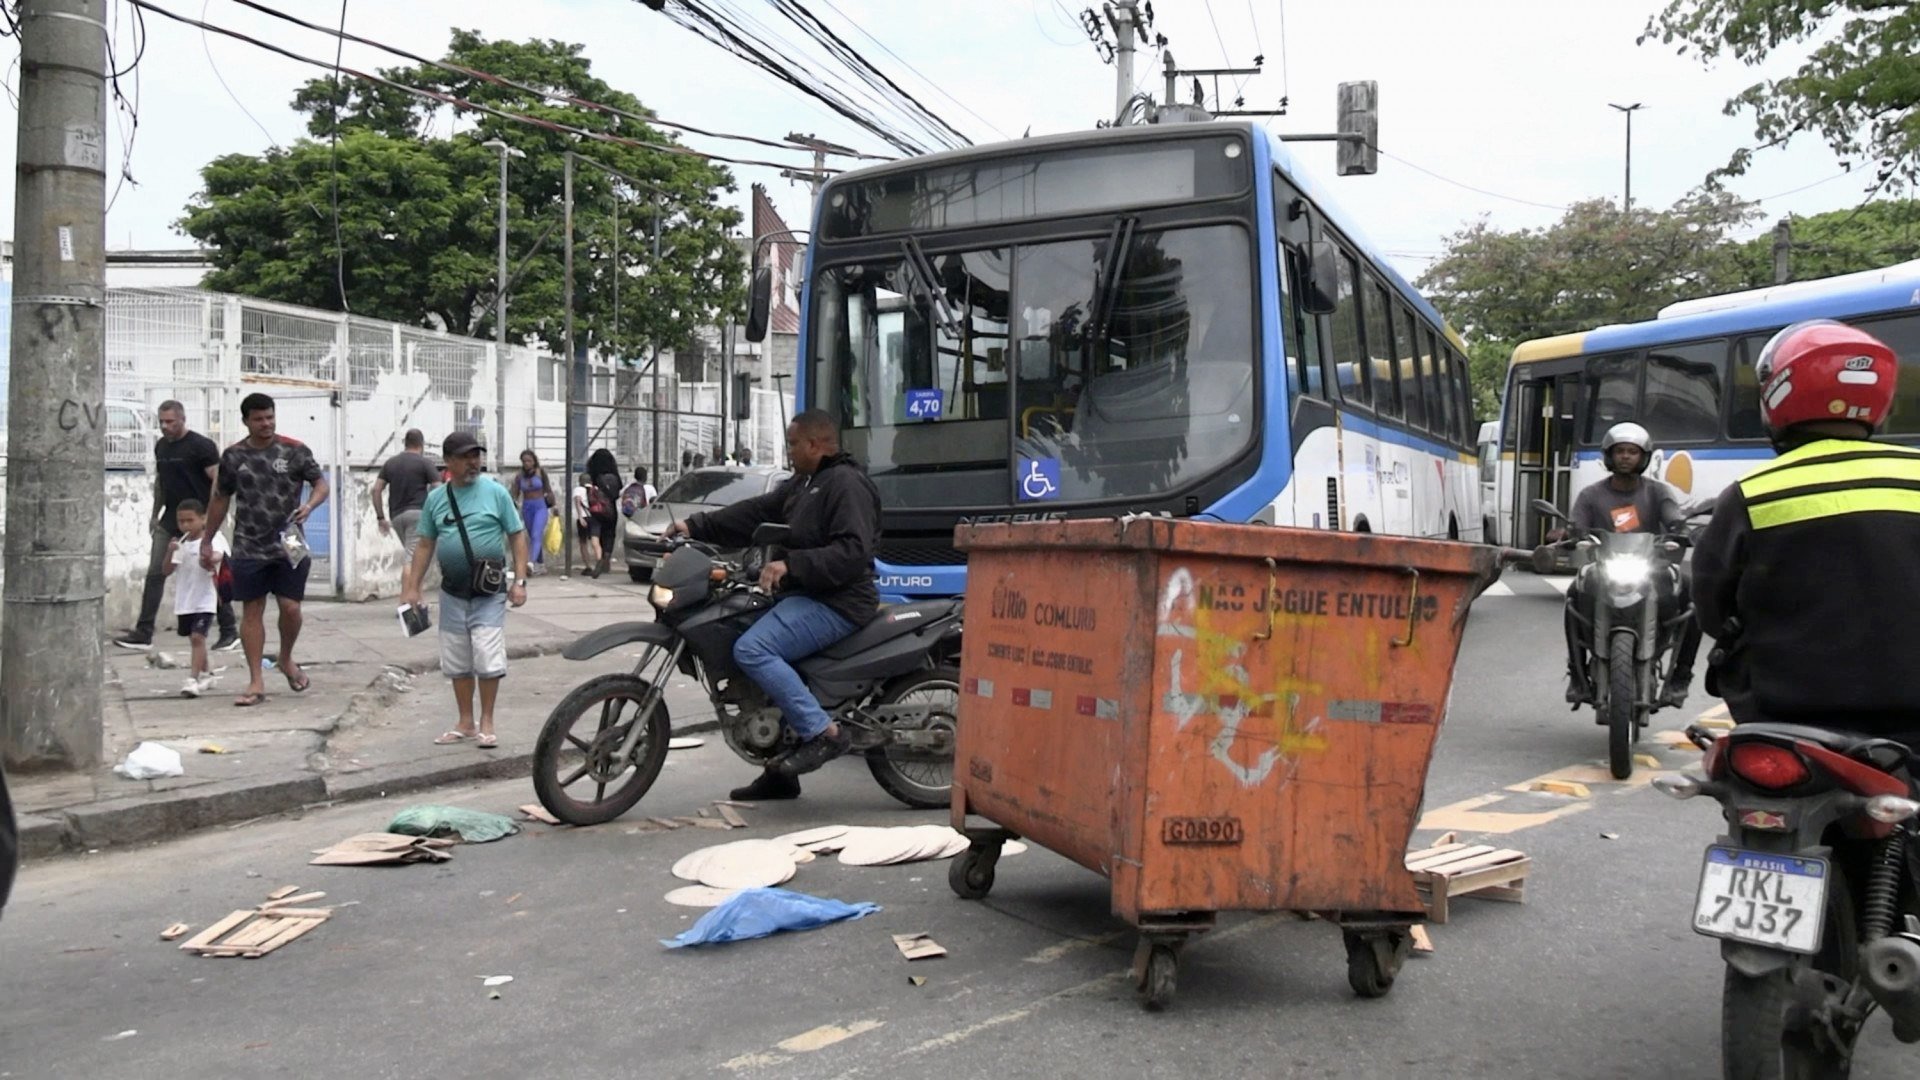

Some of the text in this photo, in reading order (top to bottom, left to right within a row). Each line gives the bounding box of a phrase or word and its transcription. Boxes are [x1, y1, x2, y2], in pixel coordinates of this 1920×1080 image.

[909, 399, 939, 416] 4,70
[1034, 603, 1096, 631] COMLURB
[1744, 859, 1786, 872] BRASIL
[1728, 868, 1792, 904] RKL
[1712, 897, 1802, 938] 7J37
